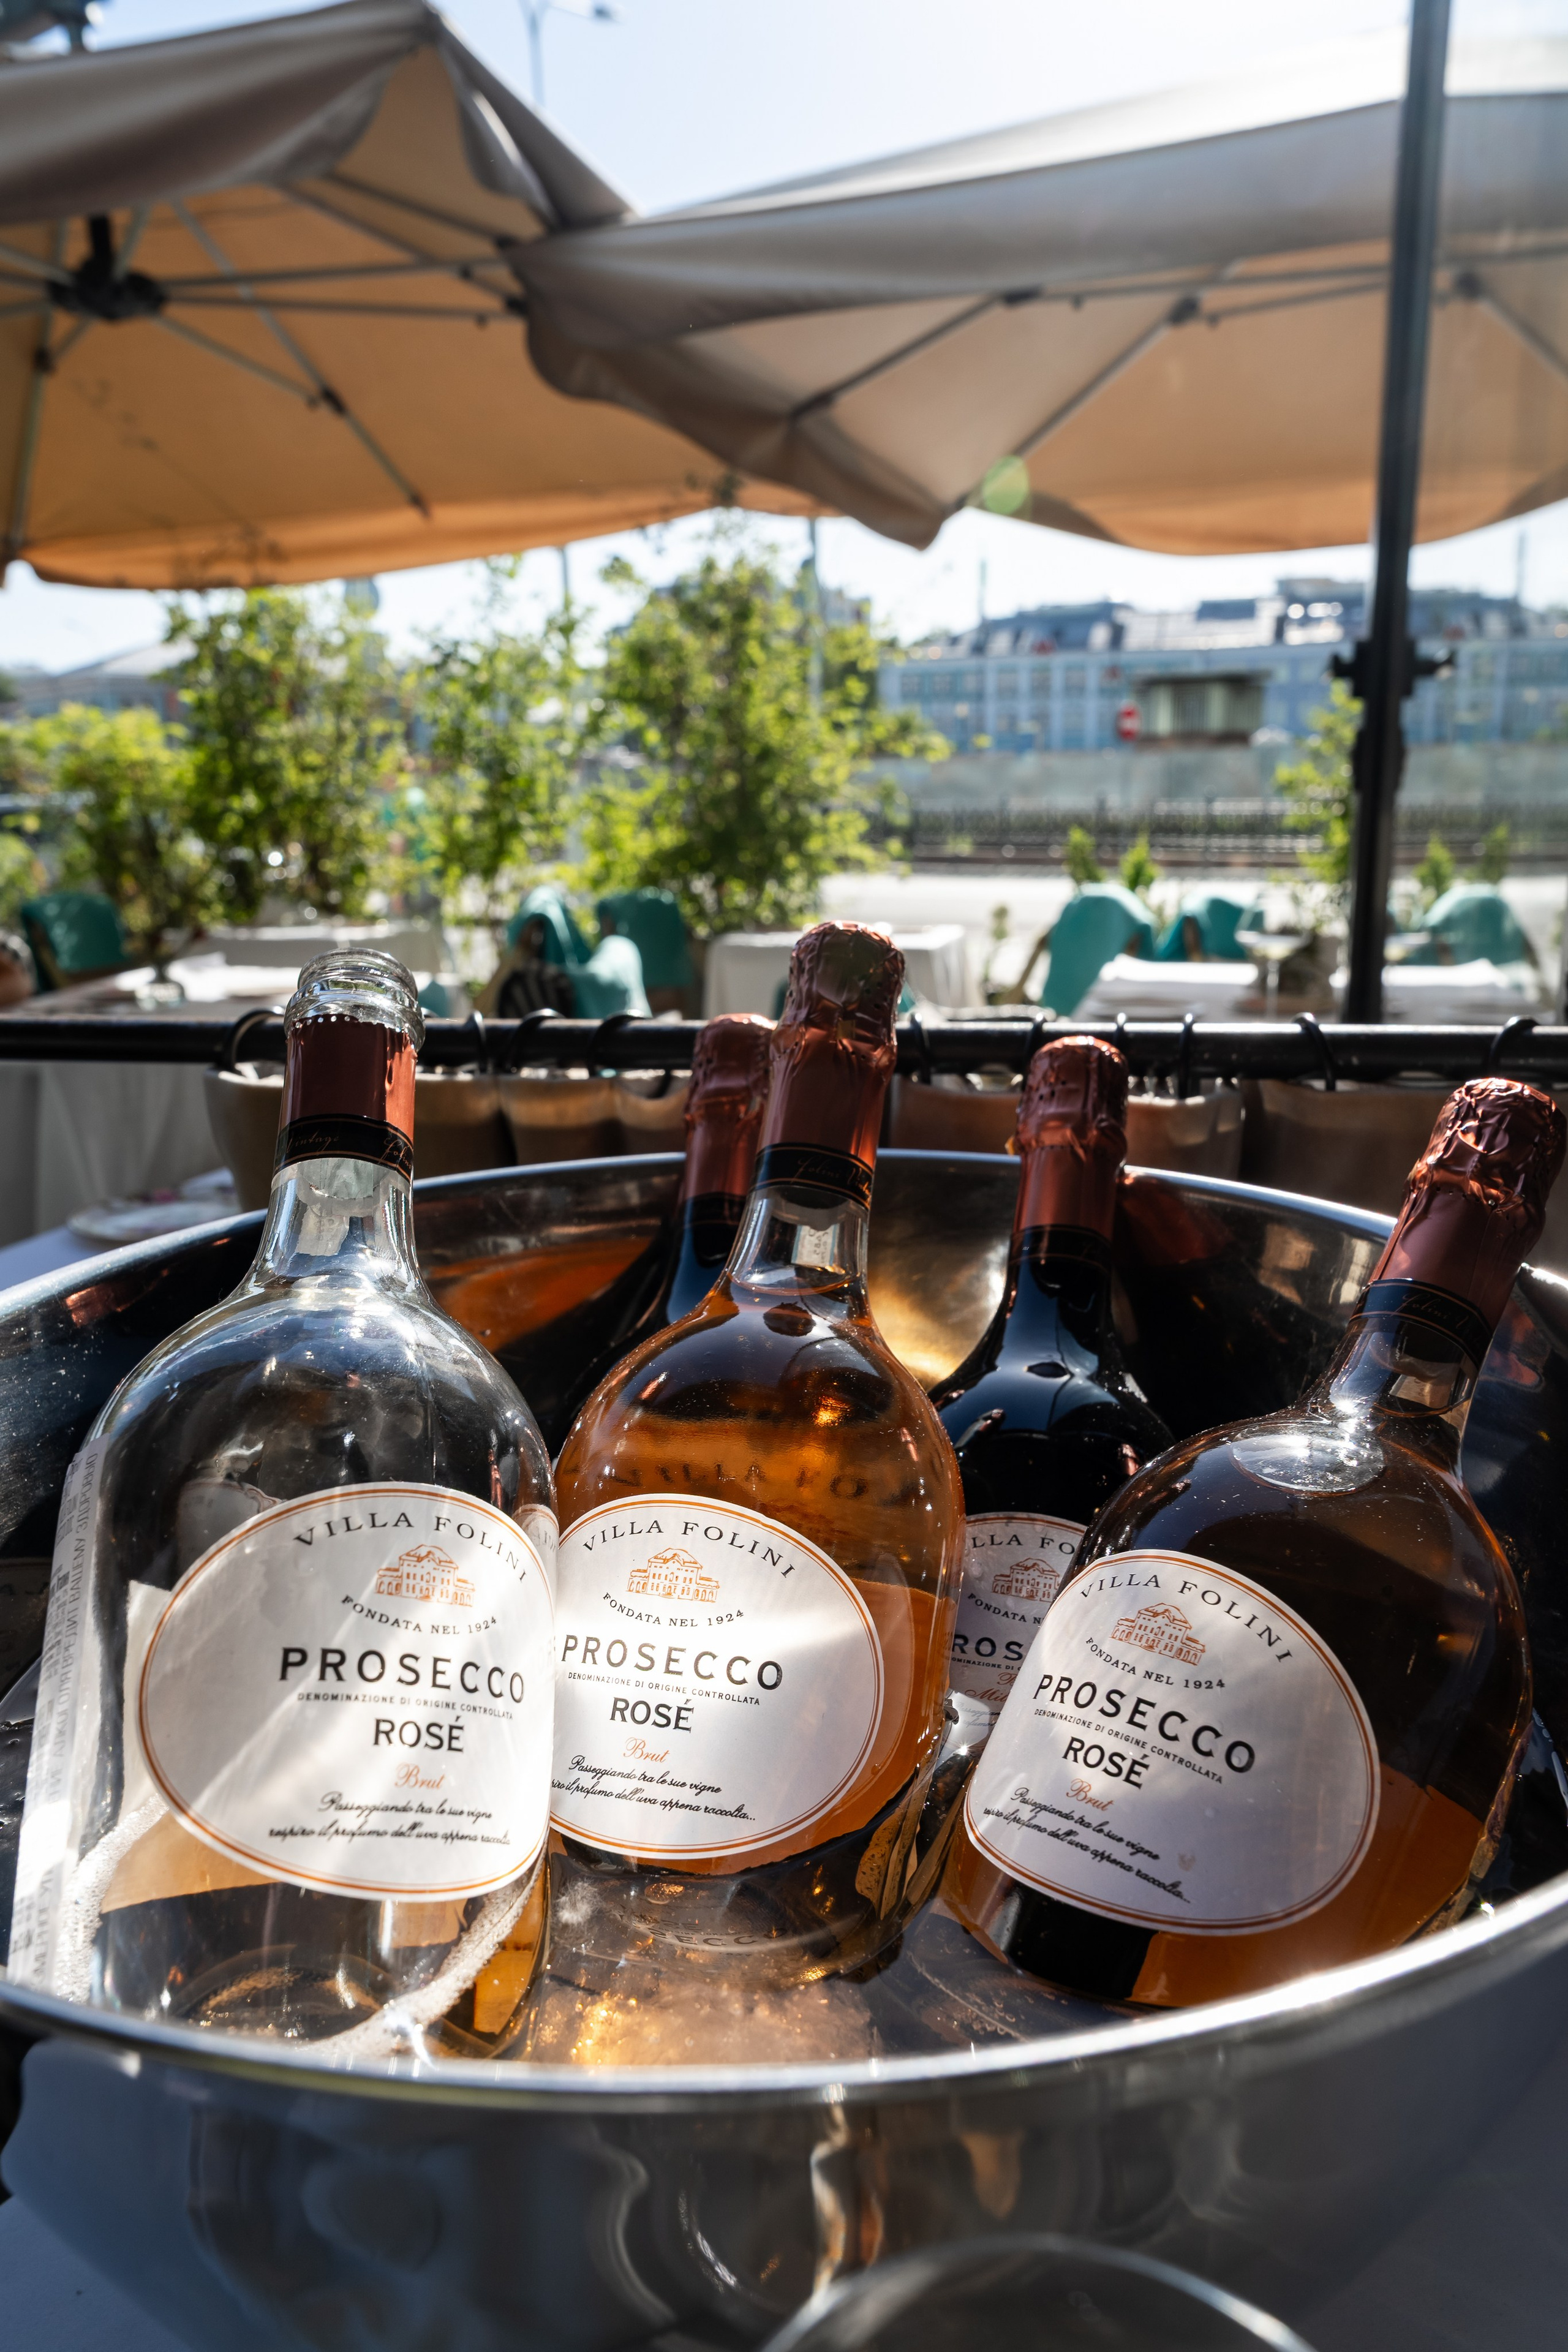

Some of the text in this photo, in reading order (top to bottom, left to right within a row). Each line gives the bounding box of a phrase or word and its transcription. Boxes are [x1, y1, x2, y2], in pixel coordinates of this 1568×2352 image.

[377, 1134, 412, 1169] Folin
[75, 1453, 99, 1533] ЗДОРОВЬЮ
[293, 1512, 414, 1547] VILLA
[434, 1516, 527, 1583] FOLINI
[582, 1520, 664, 1551] VILLA
[681, 1521, 796, 1578] FOLINI
[972, 1533, 1022, 1549] LLA
[68, 1538, 86, 1603] ВАШЕМУ
[341, 1595, 497, 1635] FONDATA NEL 1924
[603, 1592, 744, 1627] FONDATA NEL 1924
[967, 1593, 1027, 1623] FONDATA
[1080, 1573, 1293, 1662] VILLA FOLINI
[61, 1606, 80, 1670] ВРЕДИТ
[278, 1647, 525, 1704] PROSECCO
[560, 1634, 783, 1691] PROSECCO
[951, 1657, 1002, 1669] OMINAZIONE
[1085, 1637, 1226, 1689] FONDATA NEL 1924
[297, 1692, 514, 1720] DENOMINAZIONE DI ORIGINE CONTROLLATA
[568, 1672, 631, 1686] DENOMINAZIONE
[648, 1682, 687, 1694] ORIGINE
[692, 1689, 760, 1706] CONTROLLATA
[609, 1697, 695, 1733] ROSÉ
[1032, 1674, 1256, 1773] PROSECCO
[372, 1716, 464, 1752] ROSÉ
[623, 1737, 671, 1764] Brut
[1034, 1708, 1223, 1785] DENOMINAZIONE DI ORIGINE CONTROLLATA
[394, 1762, 445, 1790] Brut
[568, 1755, 722, 1796] Passeggiando tra le sue vigne
[1061, 1736, 1150, 1790] ROSÉ
[565, 1777, 580, 1790] il
[570, 1781, 613, 1799] profumo
[615, 1787, 658, 1804] dell'uva
[1065, 1777, 1115, 1811] Brut
[317, 1791, 413, 1817] Passeggiando
[416, 1800, 432, 1814] tra
[467, 1807, 492, 1824] vigne
[660, 1798, 702, 1812] appena
[703, 1804, 756, 1820] raccolta...
[1010, 1787, 1160, 1861] Passeggiando tra le sue vigne
[1047, 1828, 1090, 1852] dell'uva
[1090, 1849, 1134, 1872] appena
